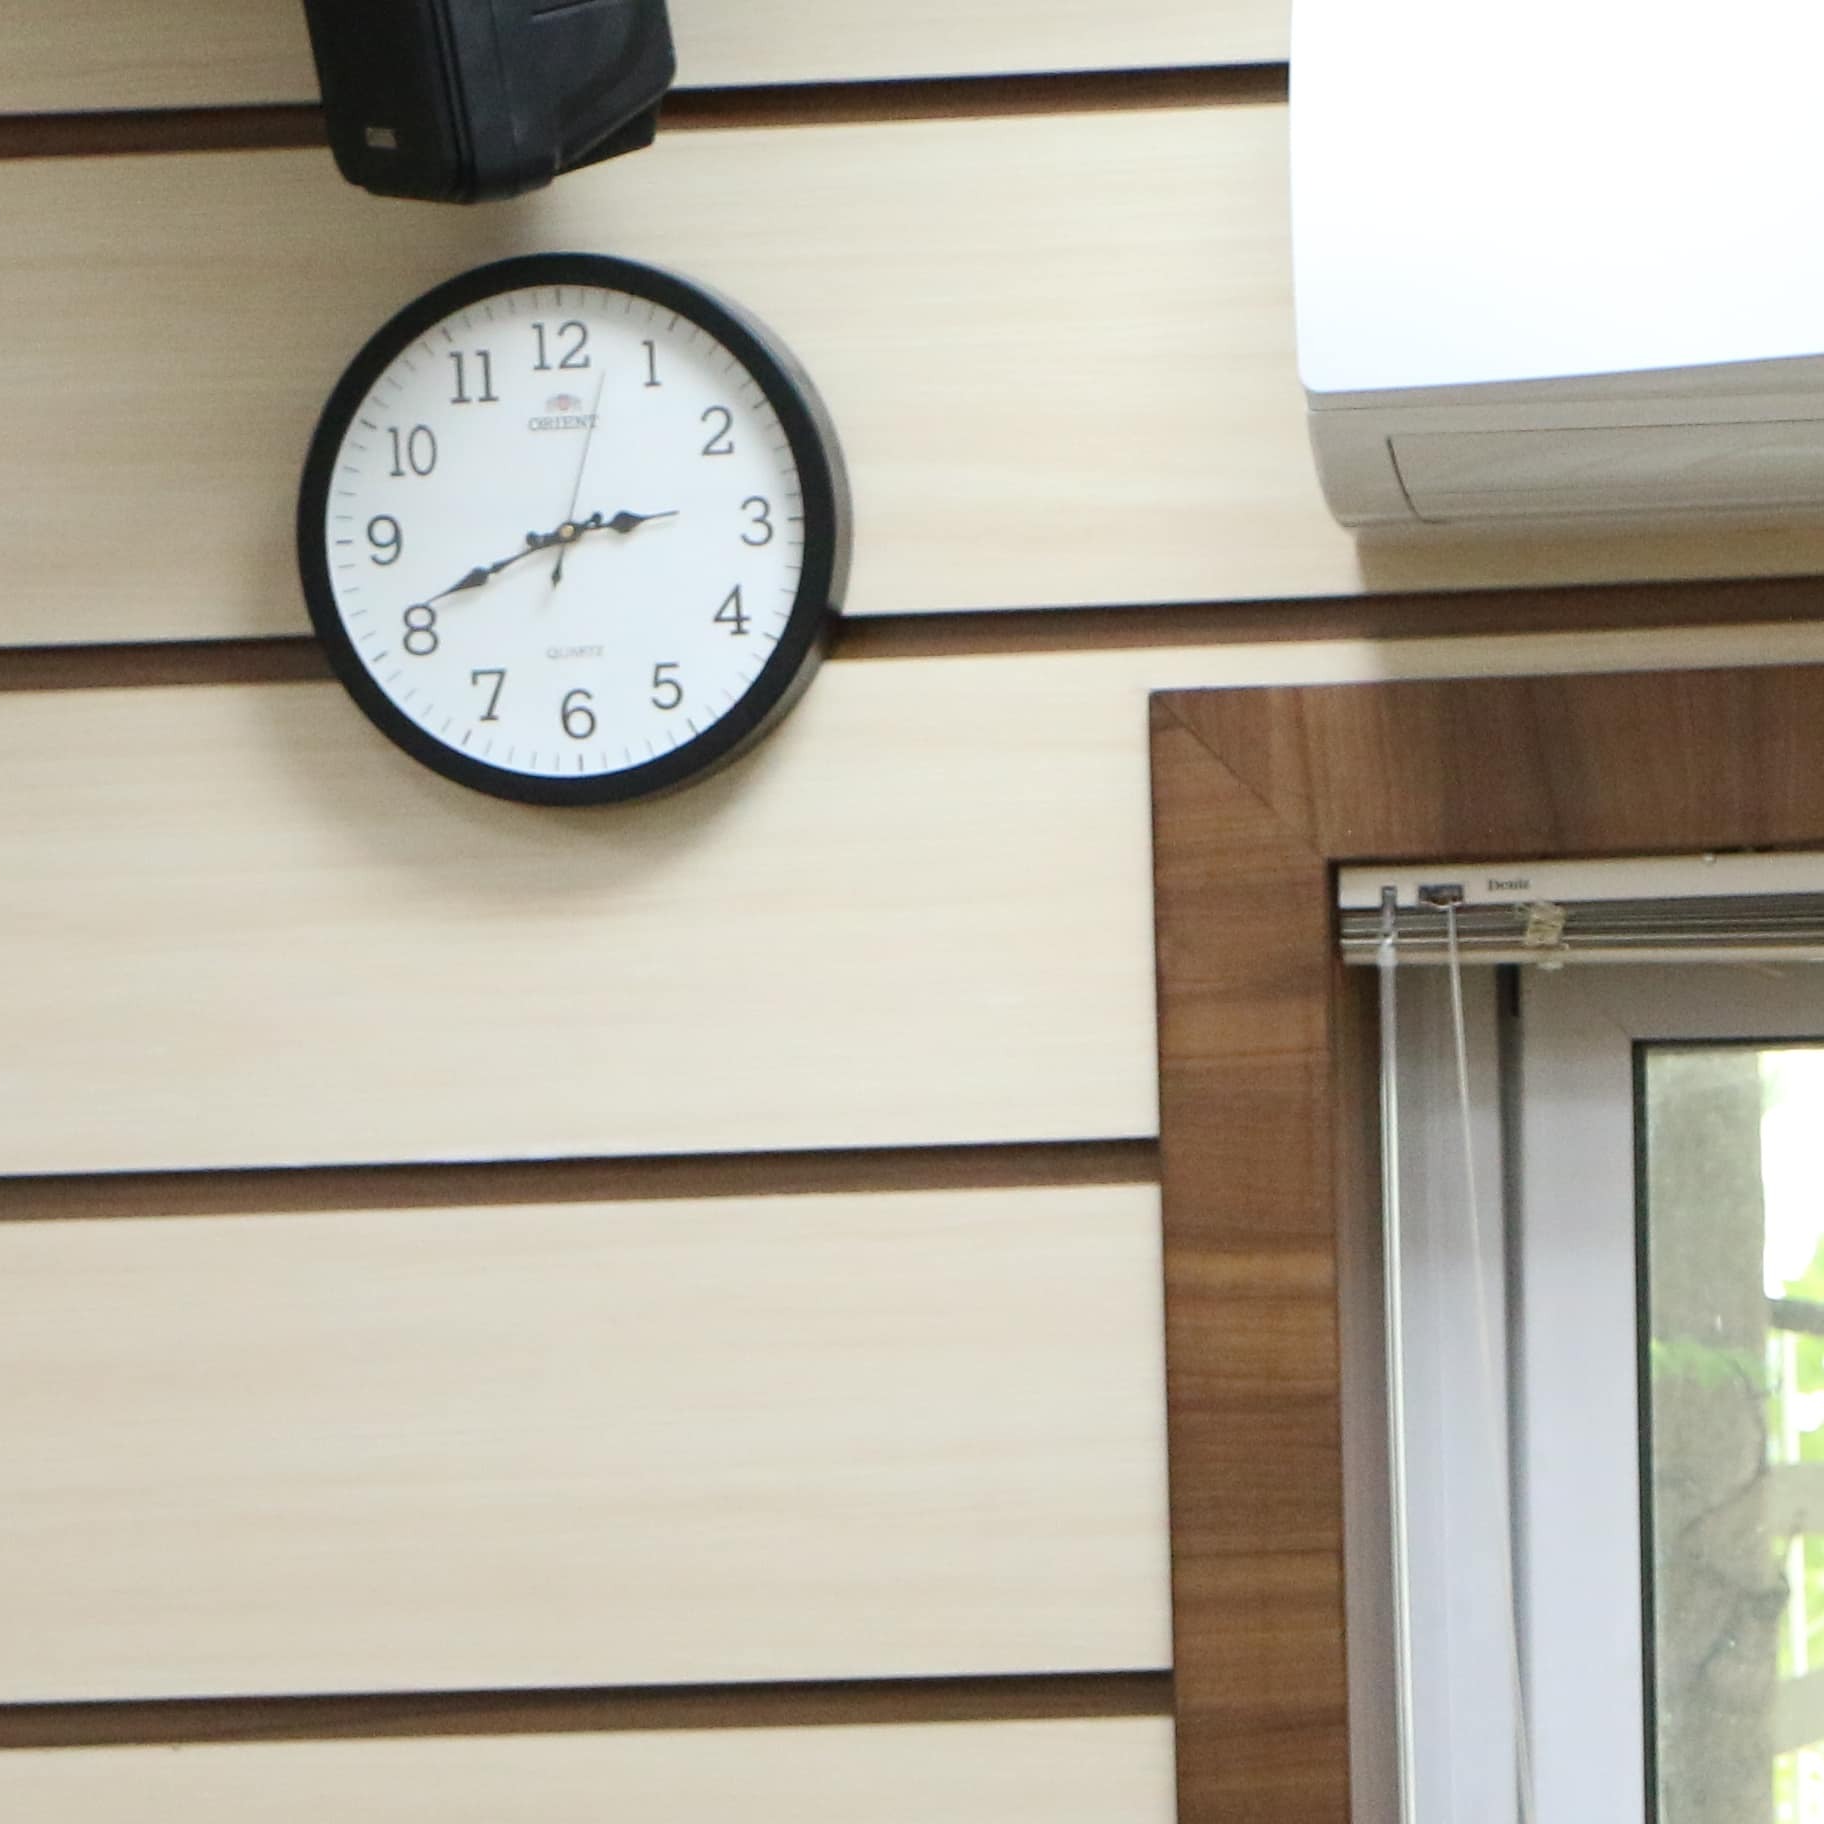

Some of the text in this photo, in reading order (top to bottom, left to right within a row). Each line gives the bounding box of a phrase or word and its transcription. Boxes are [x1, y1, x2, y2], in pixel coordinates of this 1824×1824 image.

[530, 320, 592, 372] 12
[641, 339, 663, 388] 1
[448, 349, 500, 405] 11
[527, 414, 600, 431] ORIENT
[699, 405, 735, 456] 2
[387, 423, 438, 478] 10
[366, 514, 404, 566] 9
[740, 496, 774, 547] 3
[402, 603, 440, 657] 8
[712, 583, 752, 637] 4
[470, 668, 509, 722] 7
[649, 661, 685, 711] 5
[560, 688, 597, 740] 6
